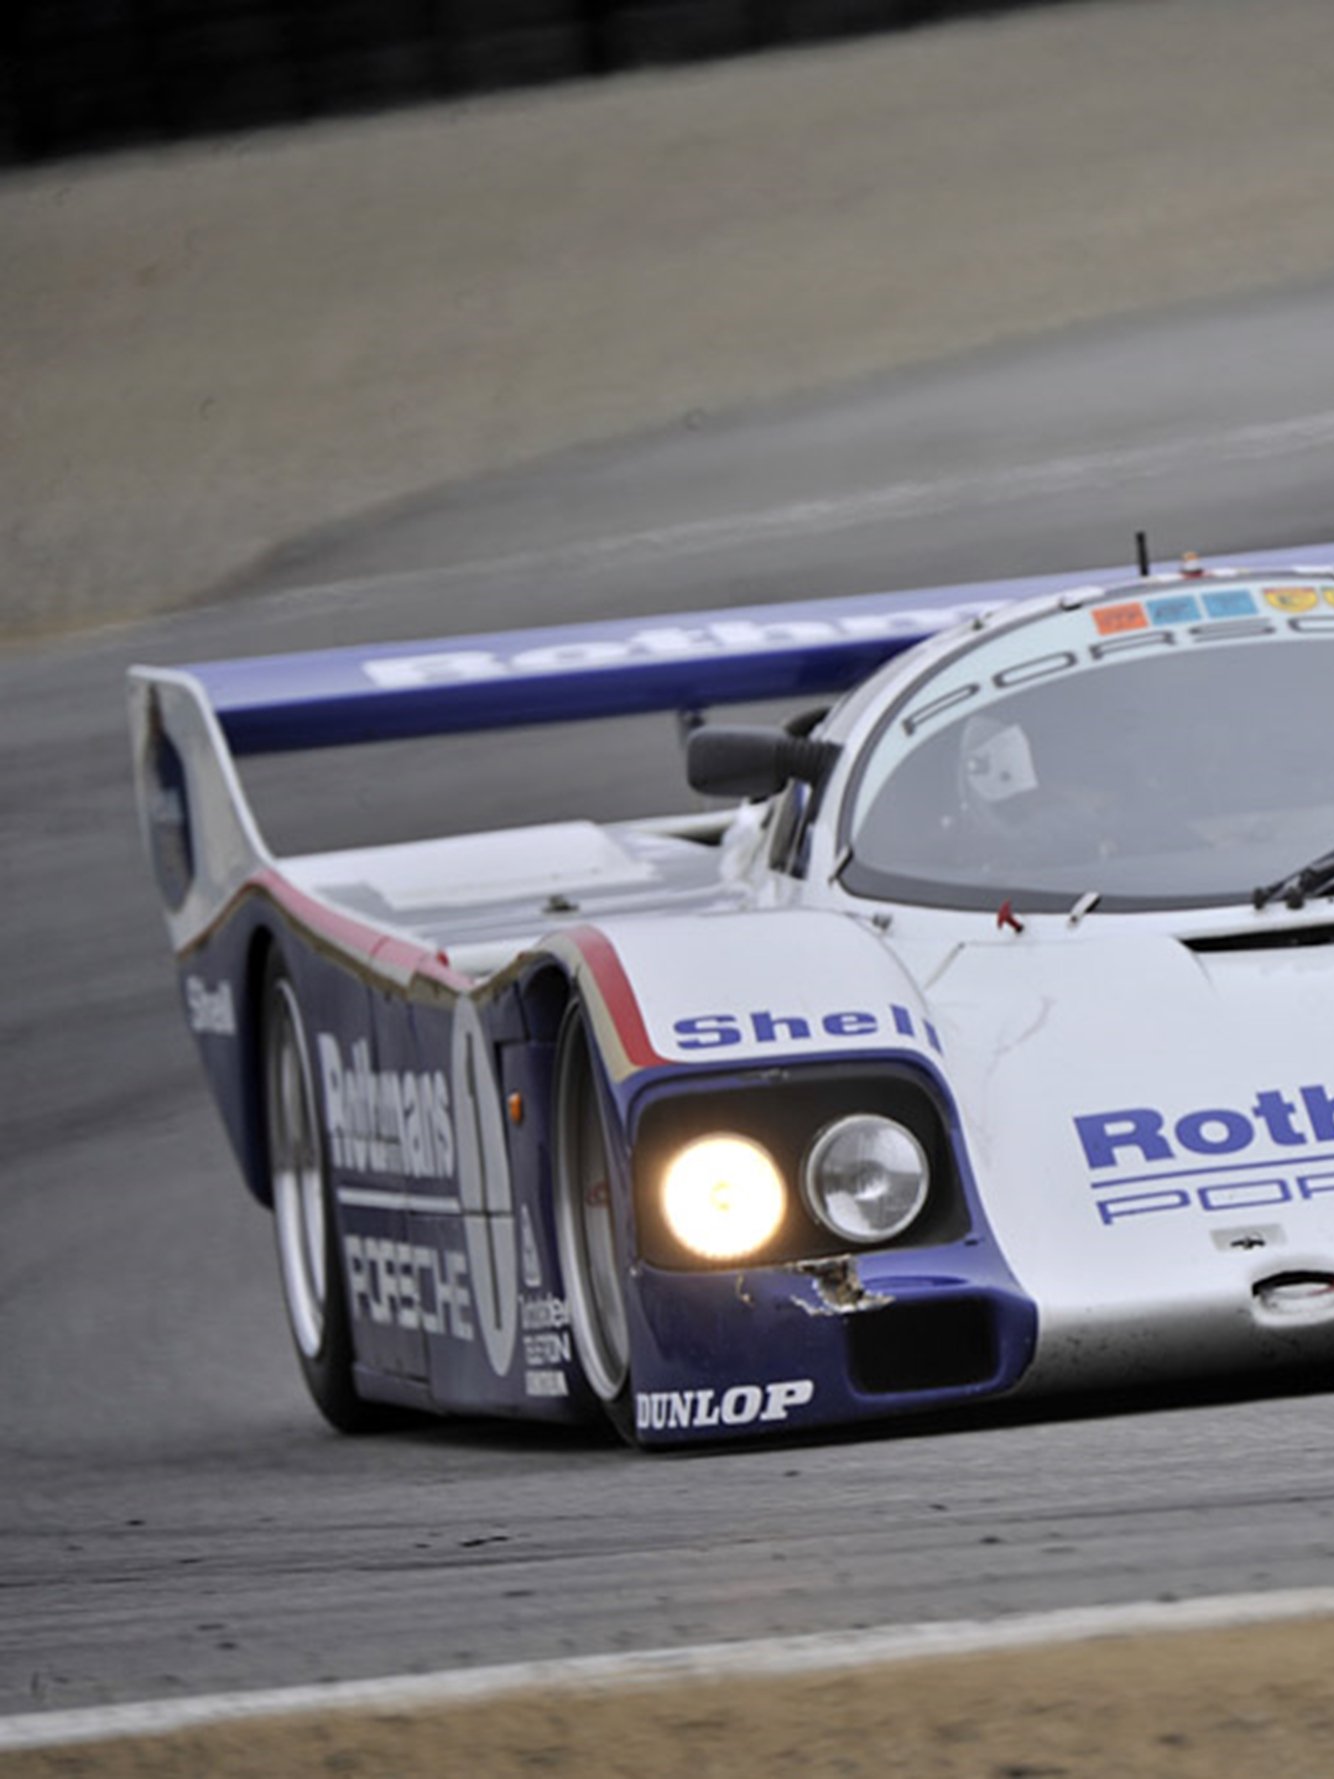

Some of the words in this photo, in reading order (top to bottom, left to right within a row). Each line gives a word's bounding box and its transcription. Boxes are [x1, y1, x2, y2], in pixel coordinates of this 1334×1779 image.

[674, 1004, 943, 1055] Shell
[344, 1234, 475, 1341] PORSCHE
[637, 1380, 814, 1429] DUNLOP
